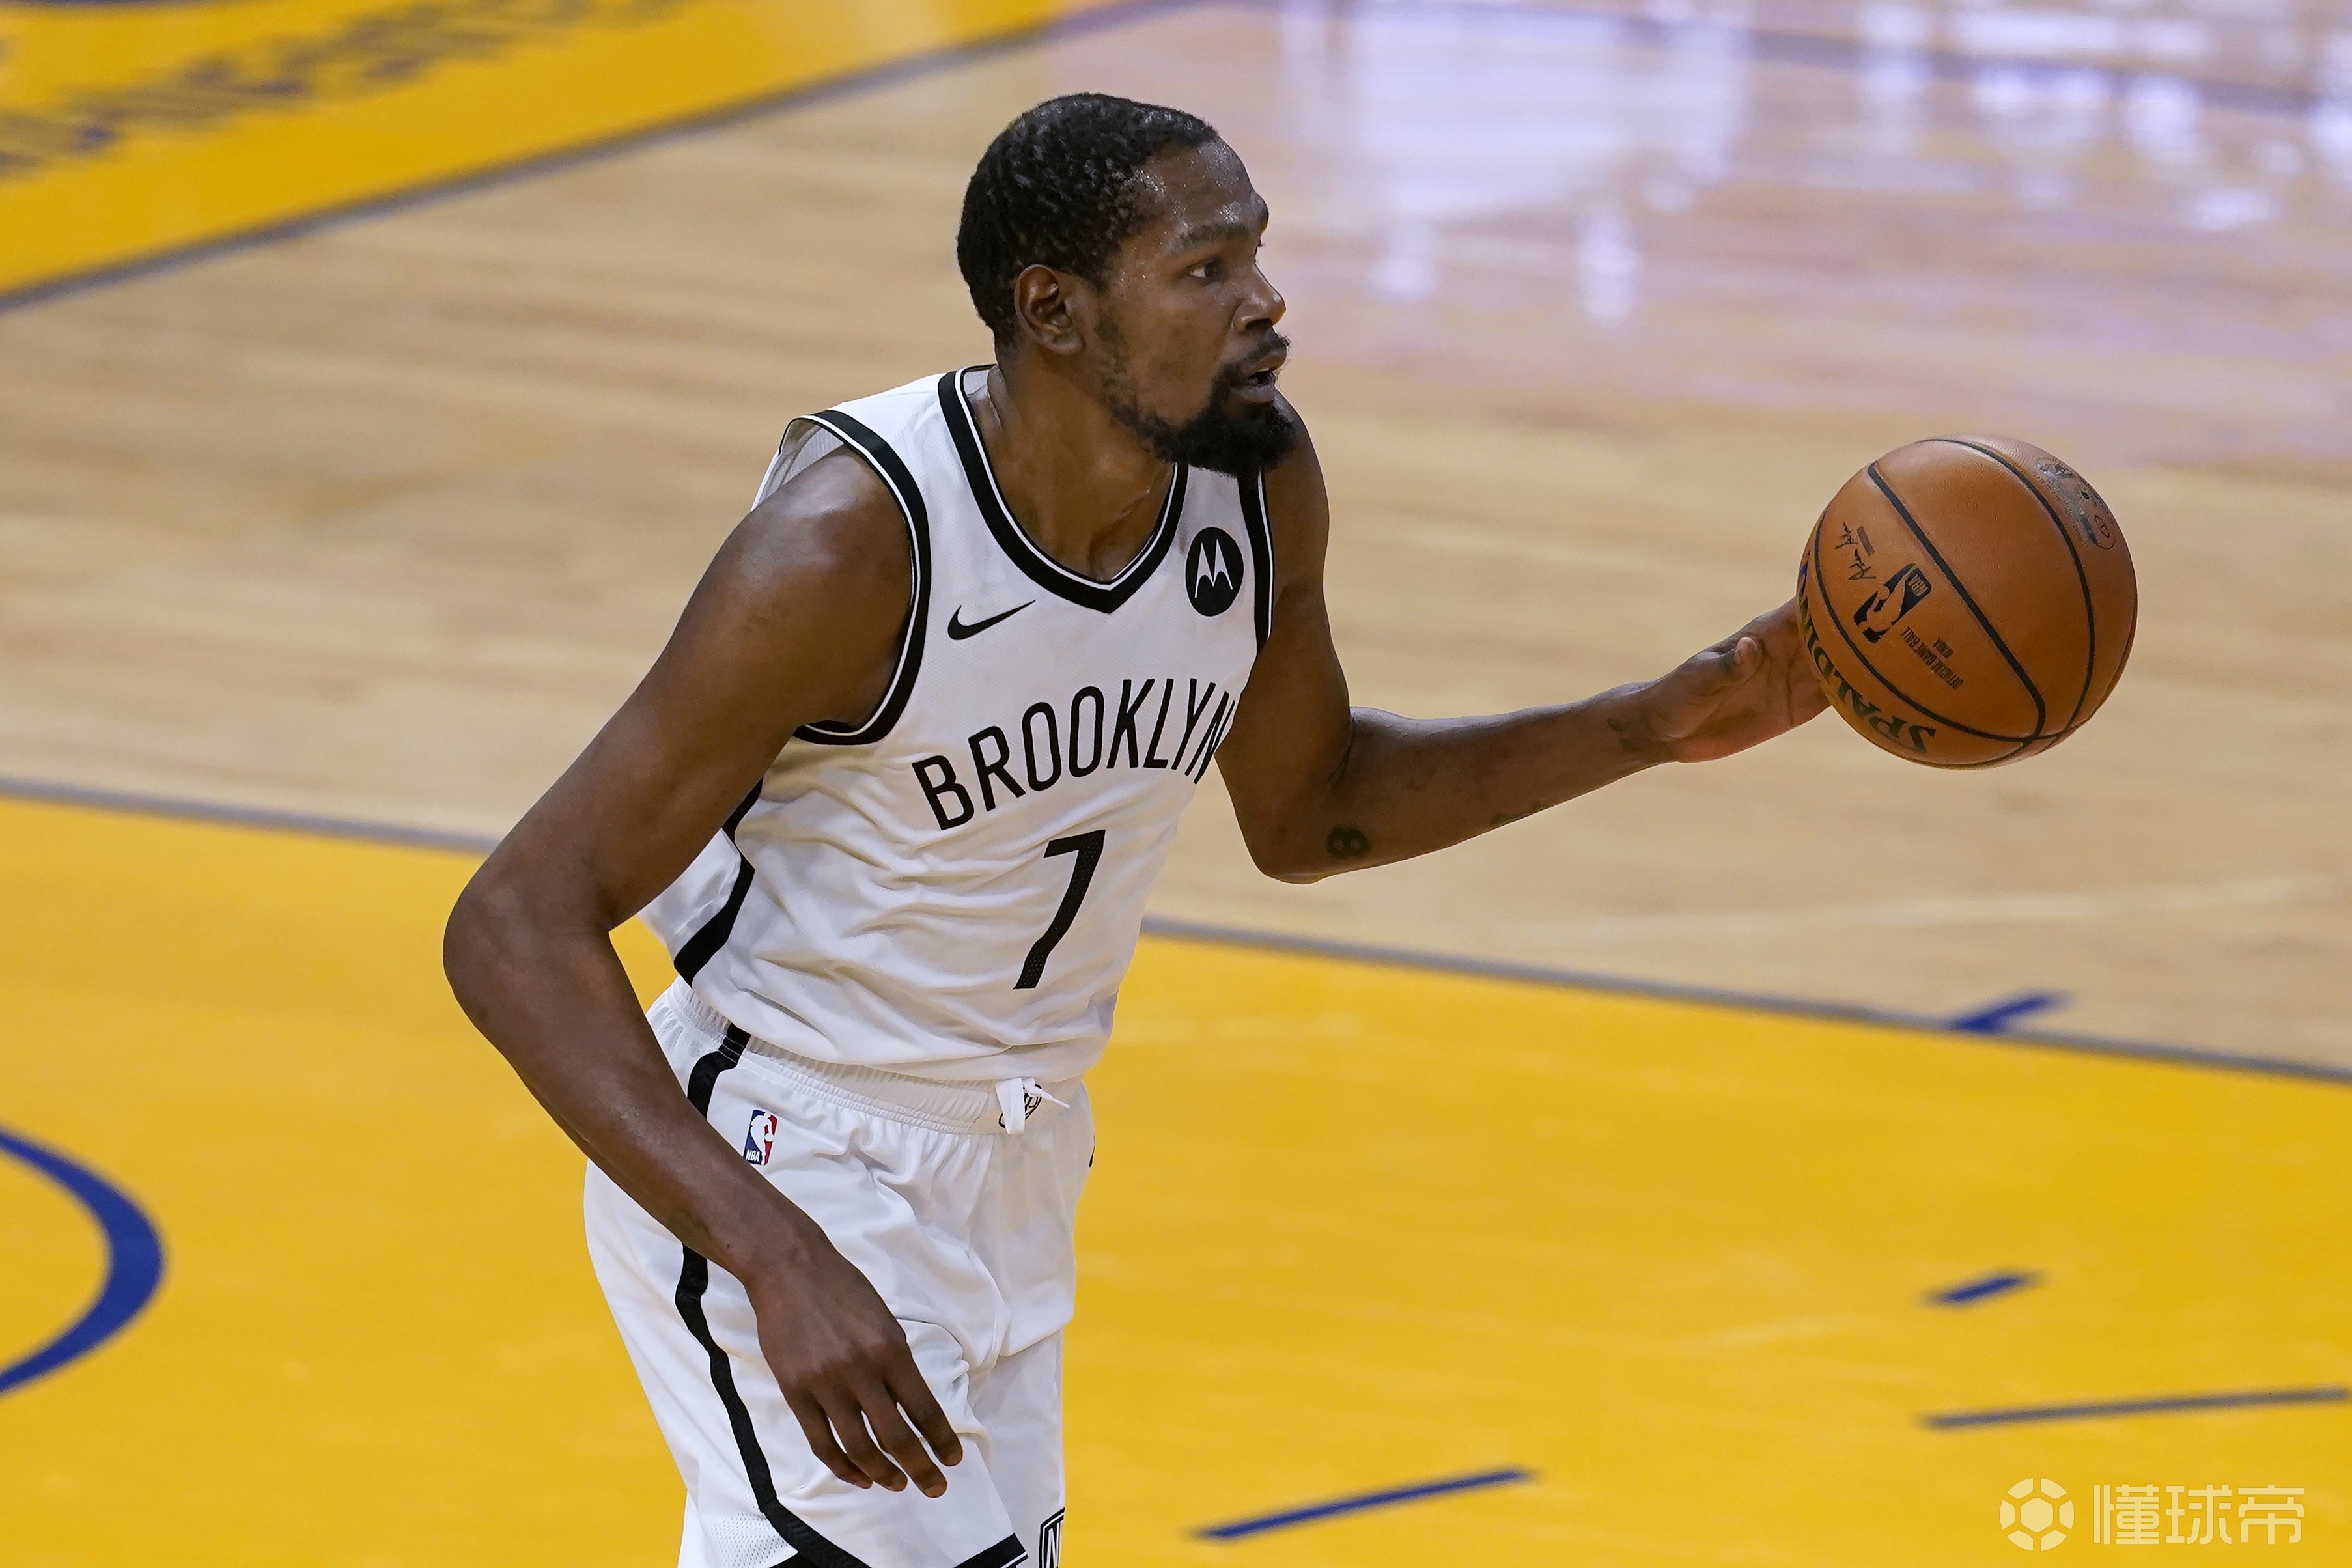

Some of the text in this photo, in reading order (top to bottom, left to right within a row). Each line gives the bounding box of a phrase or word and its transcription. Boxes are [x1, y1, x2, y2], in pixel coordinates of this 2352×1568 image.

[1908, 574, 1929, 597] NBA
[1901, 626, 1964, 688] OFFICIAL GAME BALL
[912, 678, 1235, 830] BROOKLYN
[1013, 829, 1106, 990] 7
[746, 1149, 761, 1163] NBA
